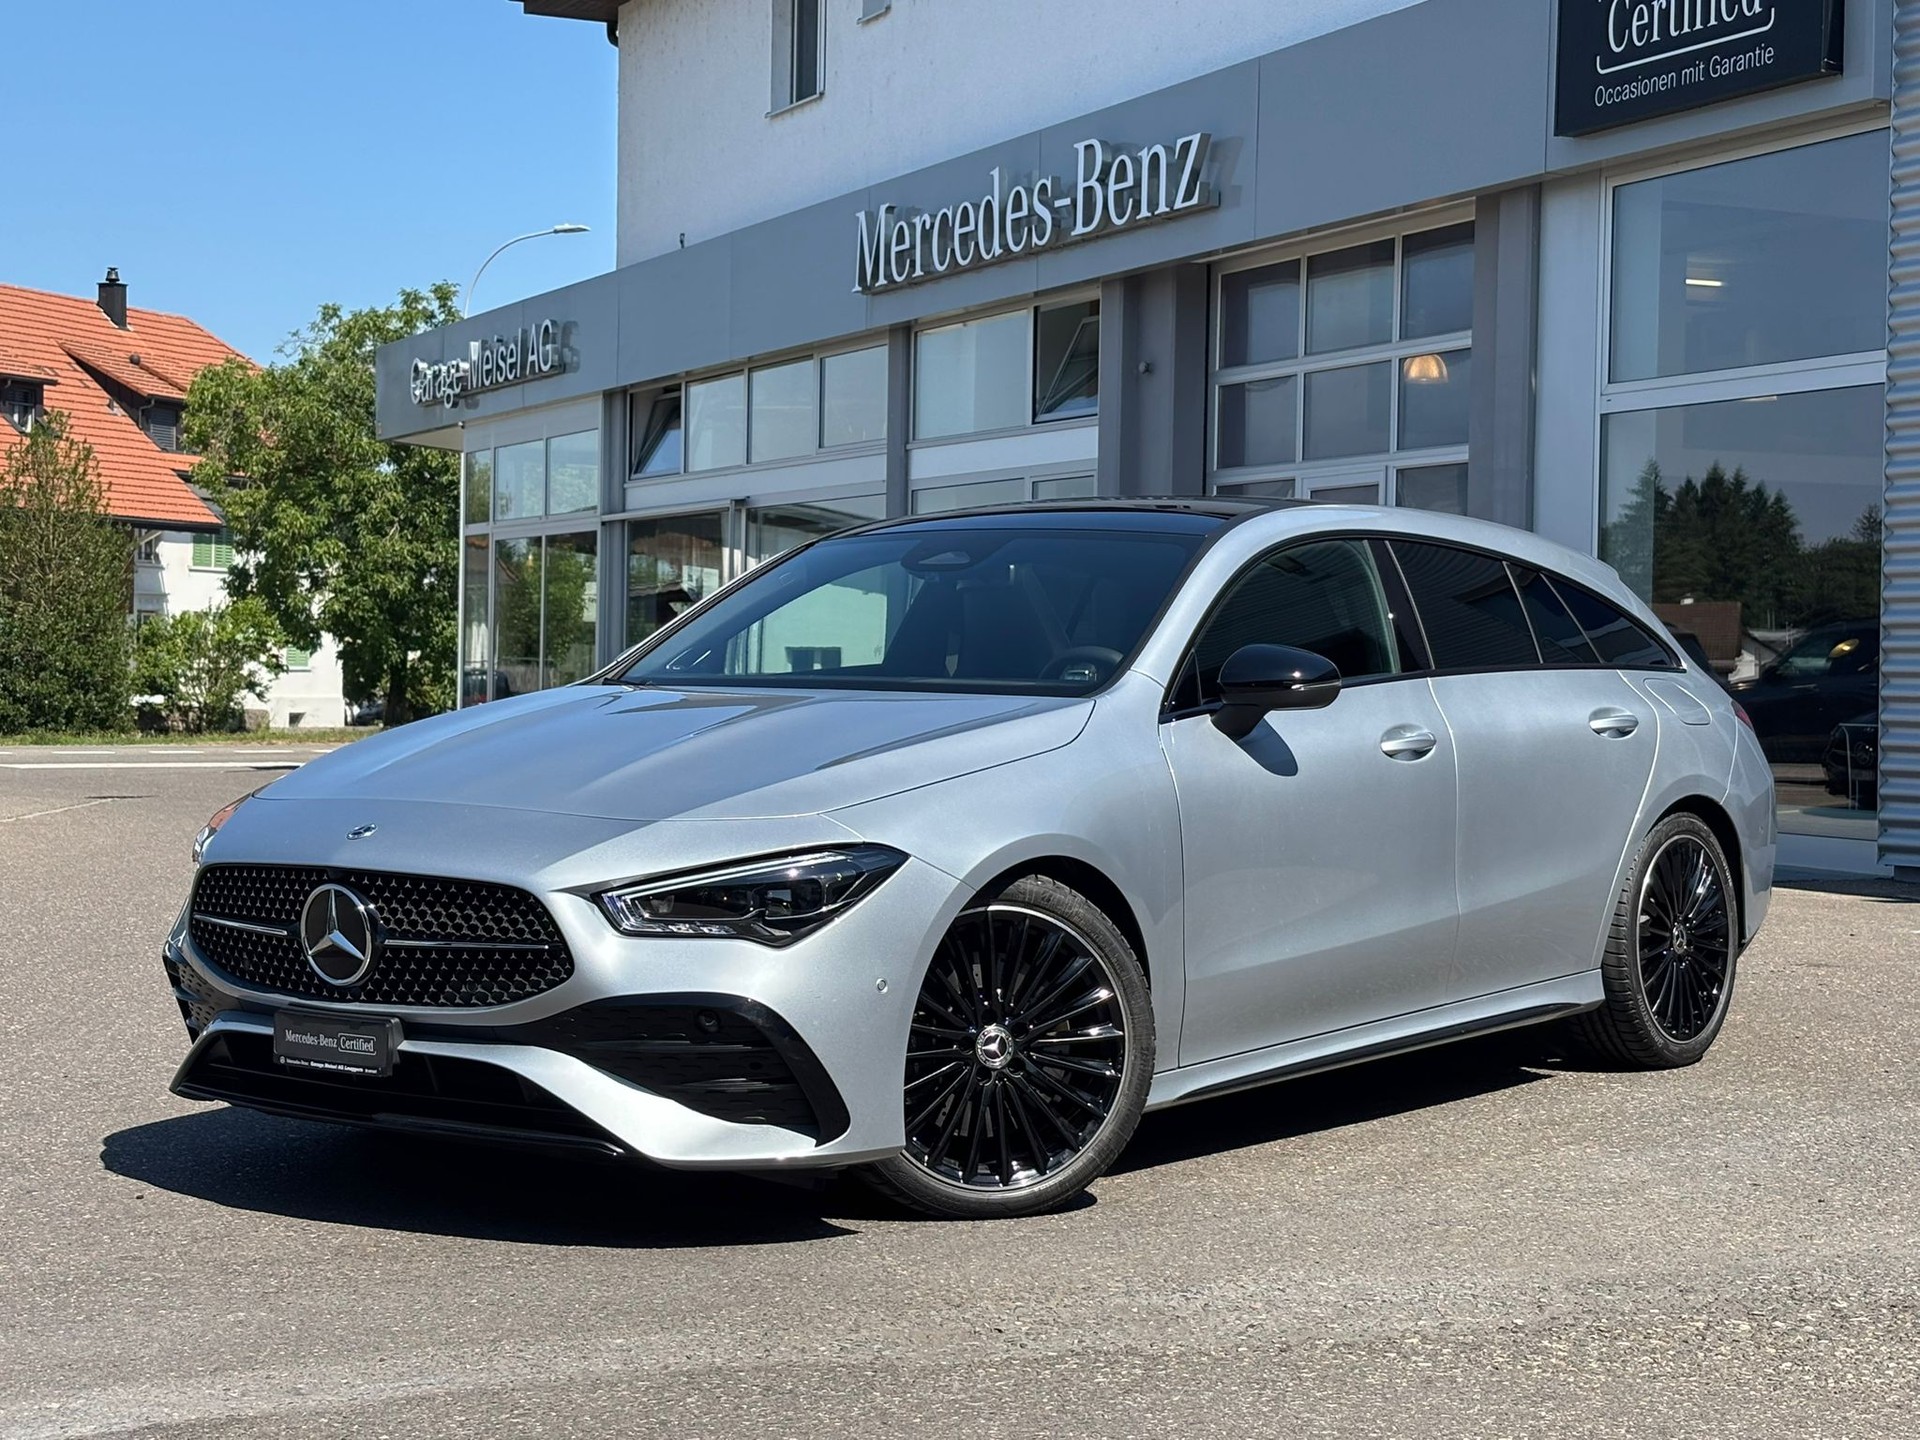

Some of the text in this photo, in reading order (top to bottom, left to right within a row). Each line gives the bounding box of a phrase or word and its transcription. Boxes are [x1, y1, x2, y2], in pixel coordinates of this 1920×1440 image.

[1594, 43, 1775, 107] Occasionen mit Garantie
[851, 132, 1205, 293] Mercedes-Benz
[410, 318, 553, 409] Garage Meisel AG
[285, 1029, 374, 1052] Mercedes-Benz Certified
